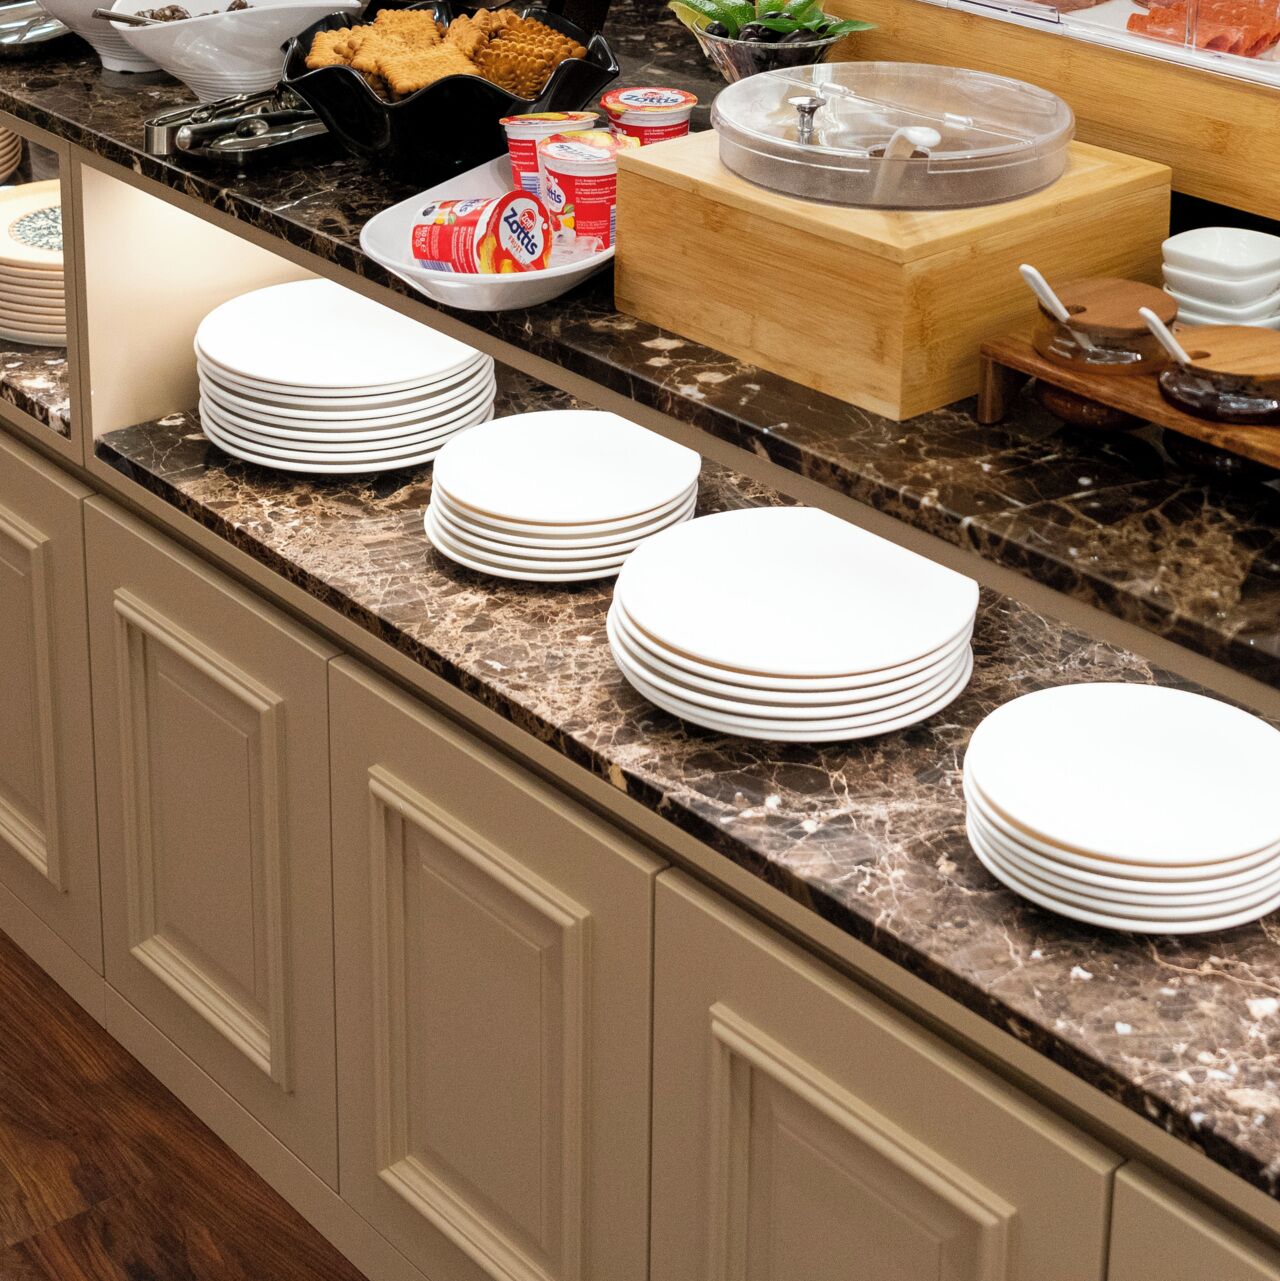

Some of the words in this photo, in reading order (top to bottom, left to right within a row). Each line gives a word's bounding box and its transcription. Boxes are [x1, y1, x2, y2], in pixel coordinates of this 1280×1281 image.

[622, 94, 679, 104] Zottis
[503, 206, 538, 256] Zottis
[508, 234, 523, 253] FRUIT
